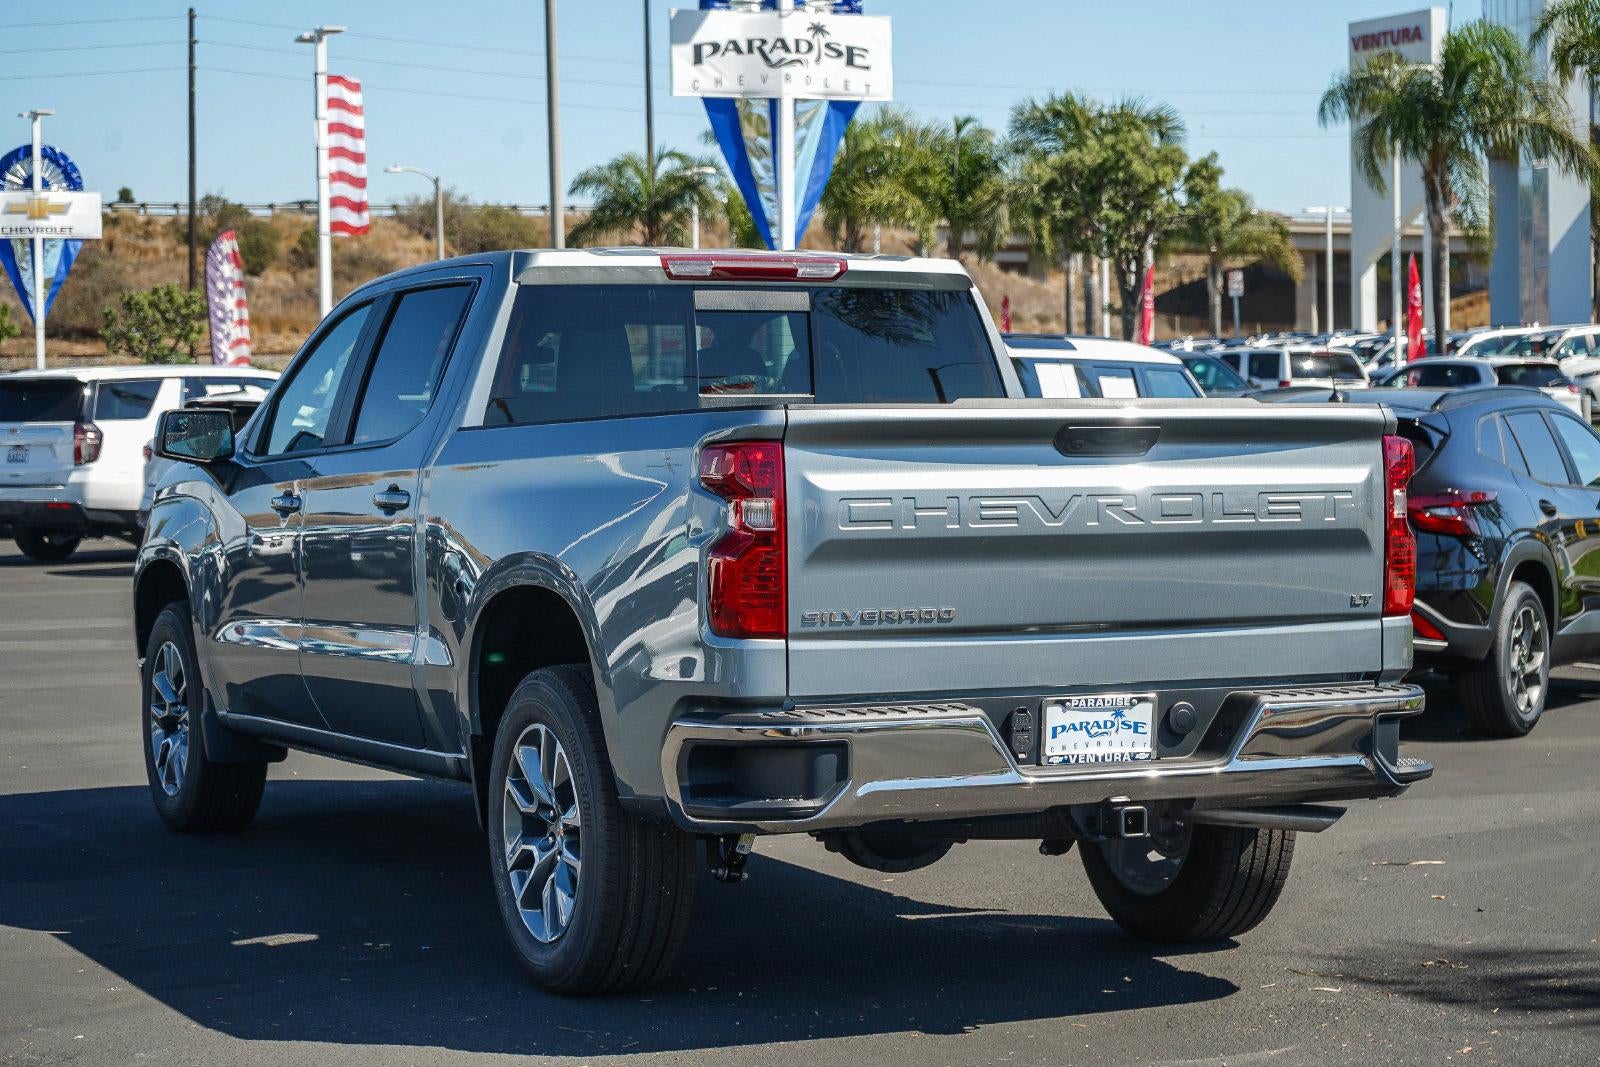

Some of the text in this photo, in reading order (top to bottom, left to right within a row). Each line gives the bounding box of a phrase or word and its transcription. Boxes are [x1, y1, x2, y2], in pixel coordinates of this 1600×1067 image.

[693, 21, 871, 71] PARADISE
[1351, 24, 1423, 51] VENTURA
[691, 74, 871, 95] CHEVROLET
[1, 225, 75, 235] CHEVROLET
[838, 491, 1353, 531] CHEVROLET
[1350, 593, 1374, 608] LT
[801, 607, 956, 627] SILVERADO
[1071, 697, 1131, 708] PARADISE
[1051, 708, 1148, 740] PARADISE
[1050, 740, 1148, 753] CHEVROLET
[1069, 752, 1132, 765] VENTURA
